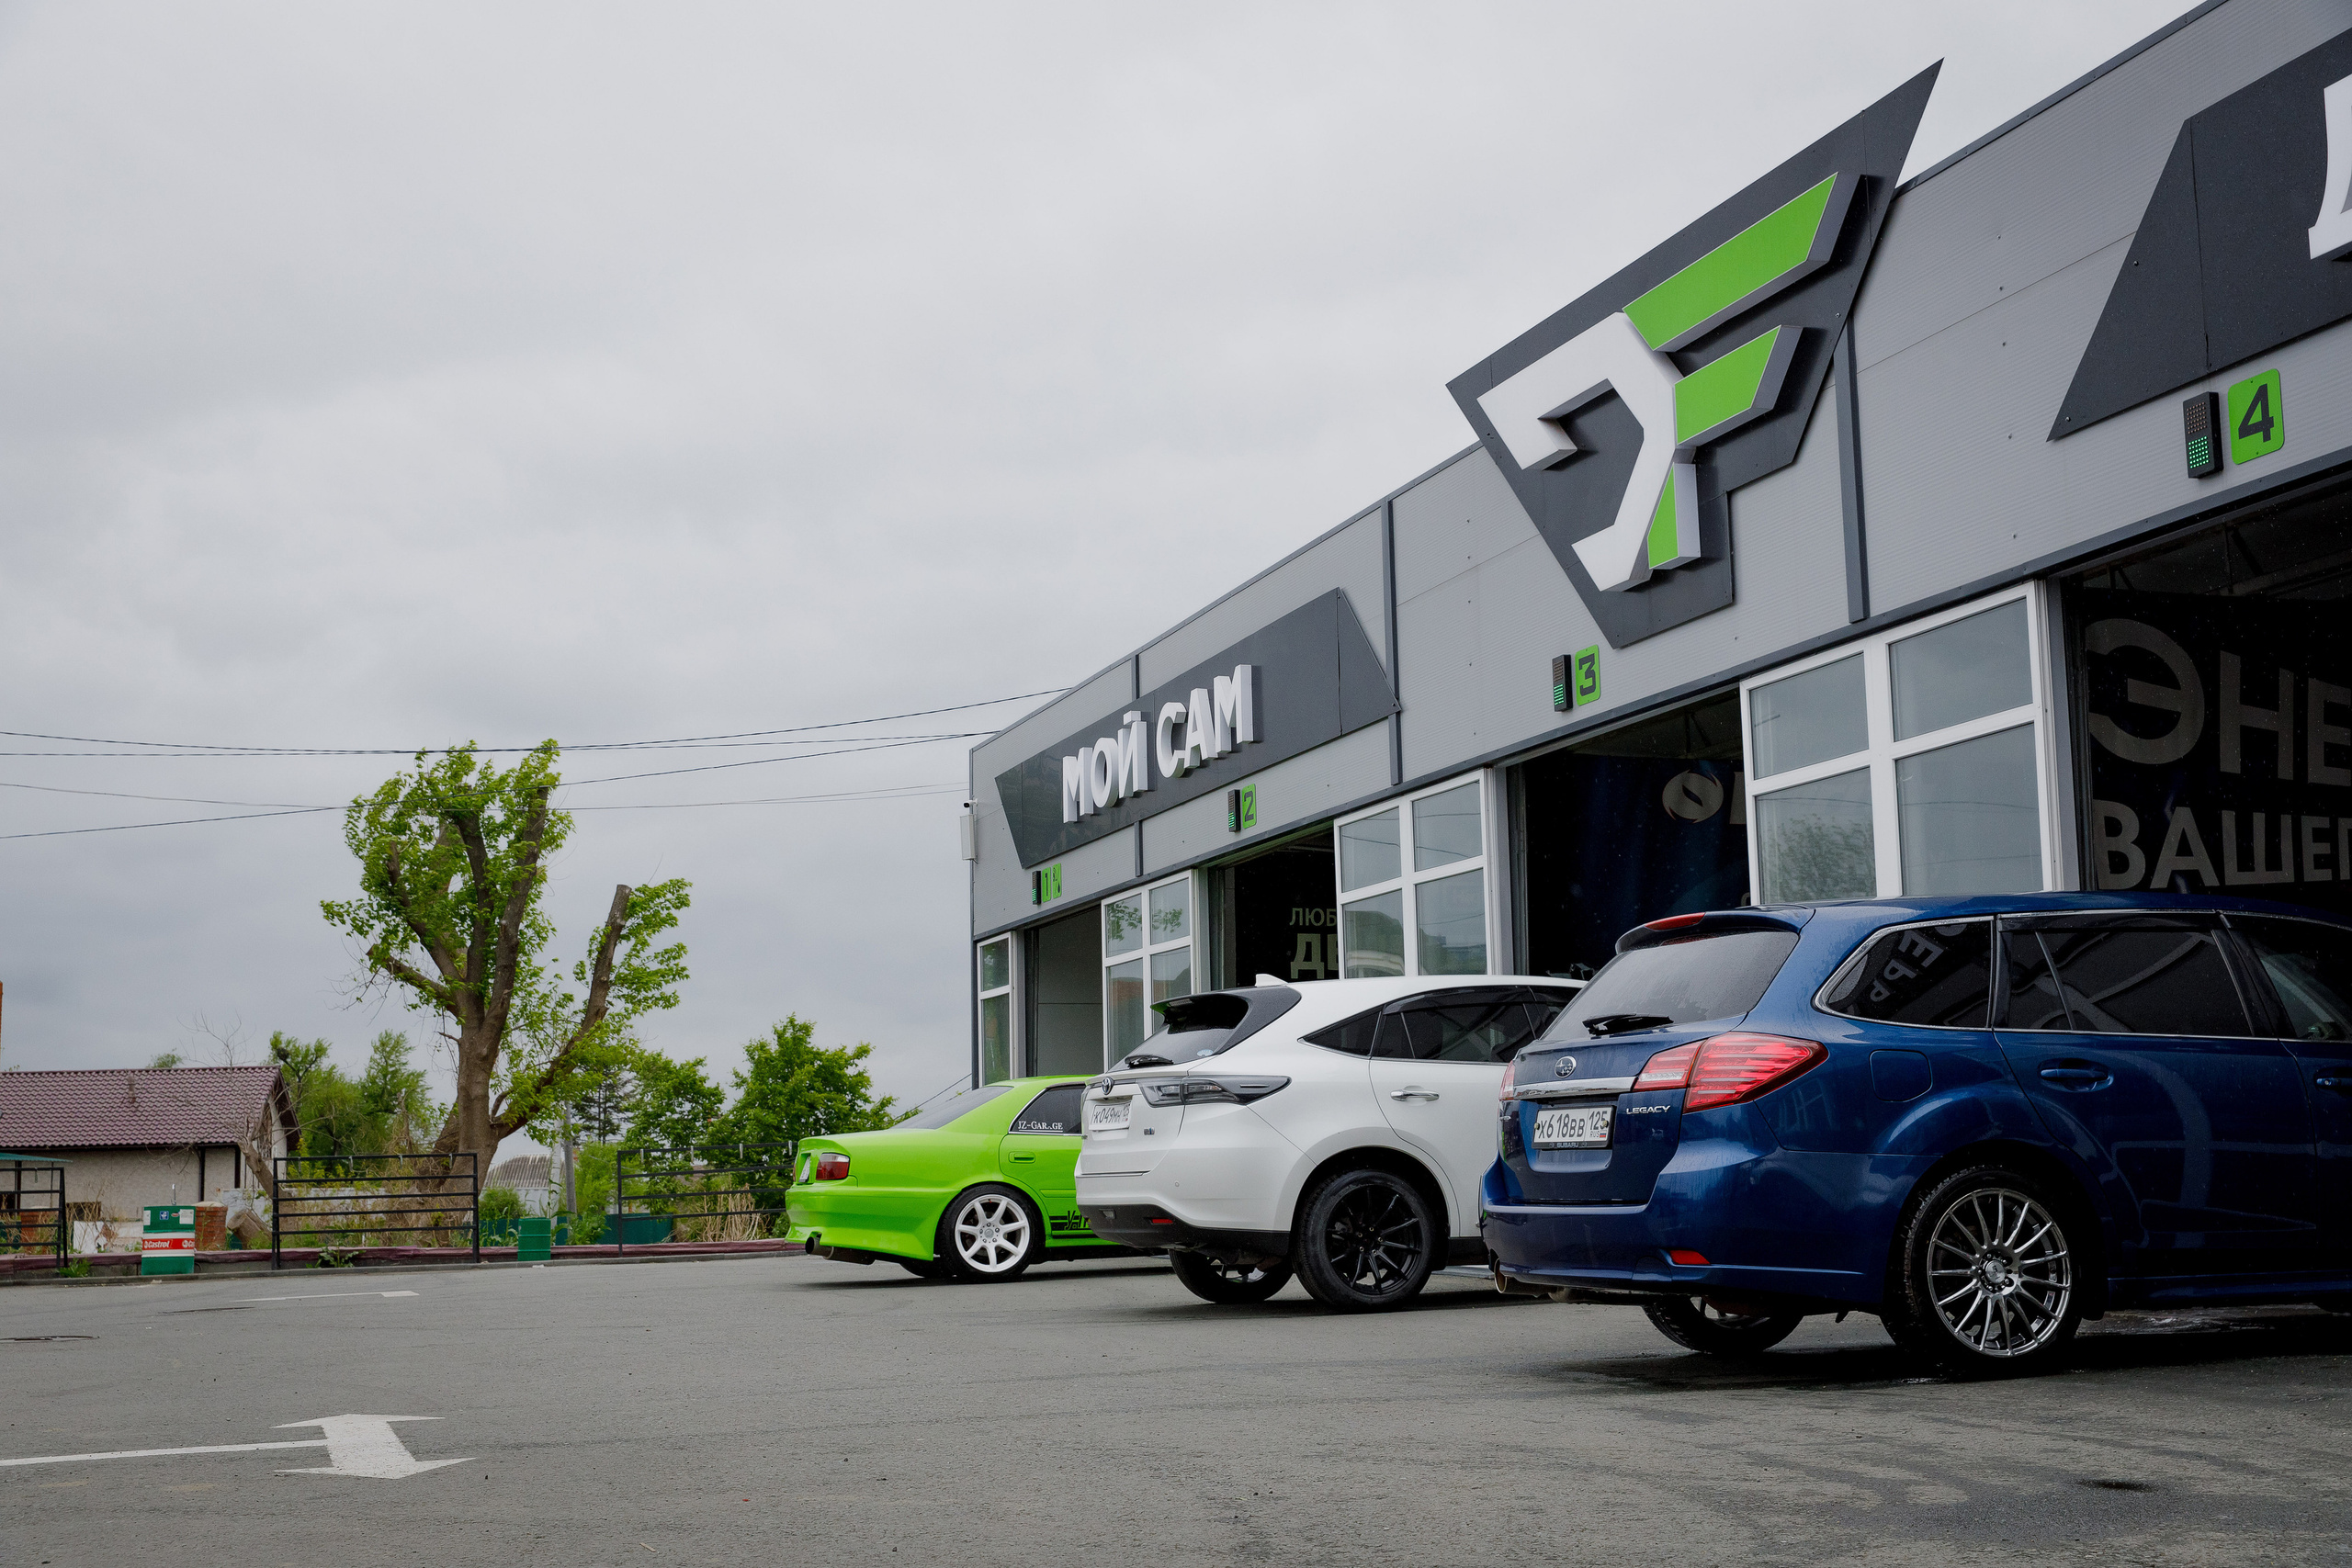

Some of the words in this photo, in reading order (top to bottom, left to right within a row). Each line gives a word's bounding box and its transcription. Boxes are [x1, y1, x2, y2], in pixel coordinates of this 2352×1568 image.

[2238, 382, 2275, 444] 4
[1577, 653, 1597, 697] 3
[2085, 618, 2352, 787] ЭНЕ
[1063, 710, 1148, 824] МОЙ
[1156, 664, 1254, 778] САМ
[1243, 790, 1254, 823] 2
[1589, 1111, 1608, 1131] 125
[1625, 1105, 1671, 1115] LEGACY
[148, 1240, 170, 1248] Castrol
